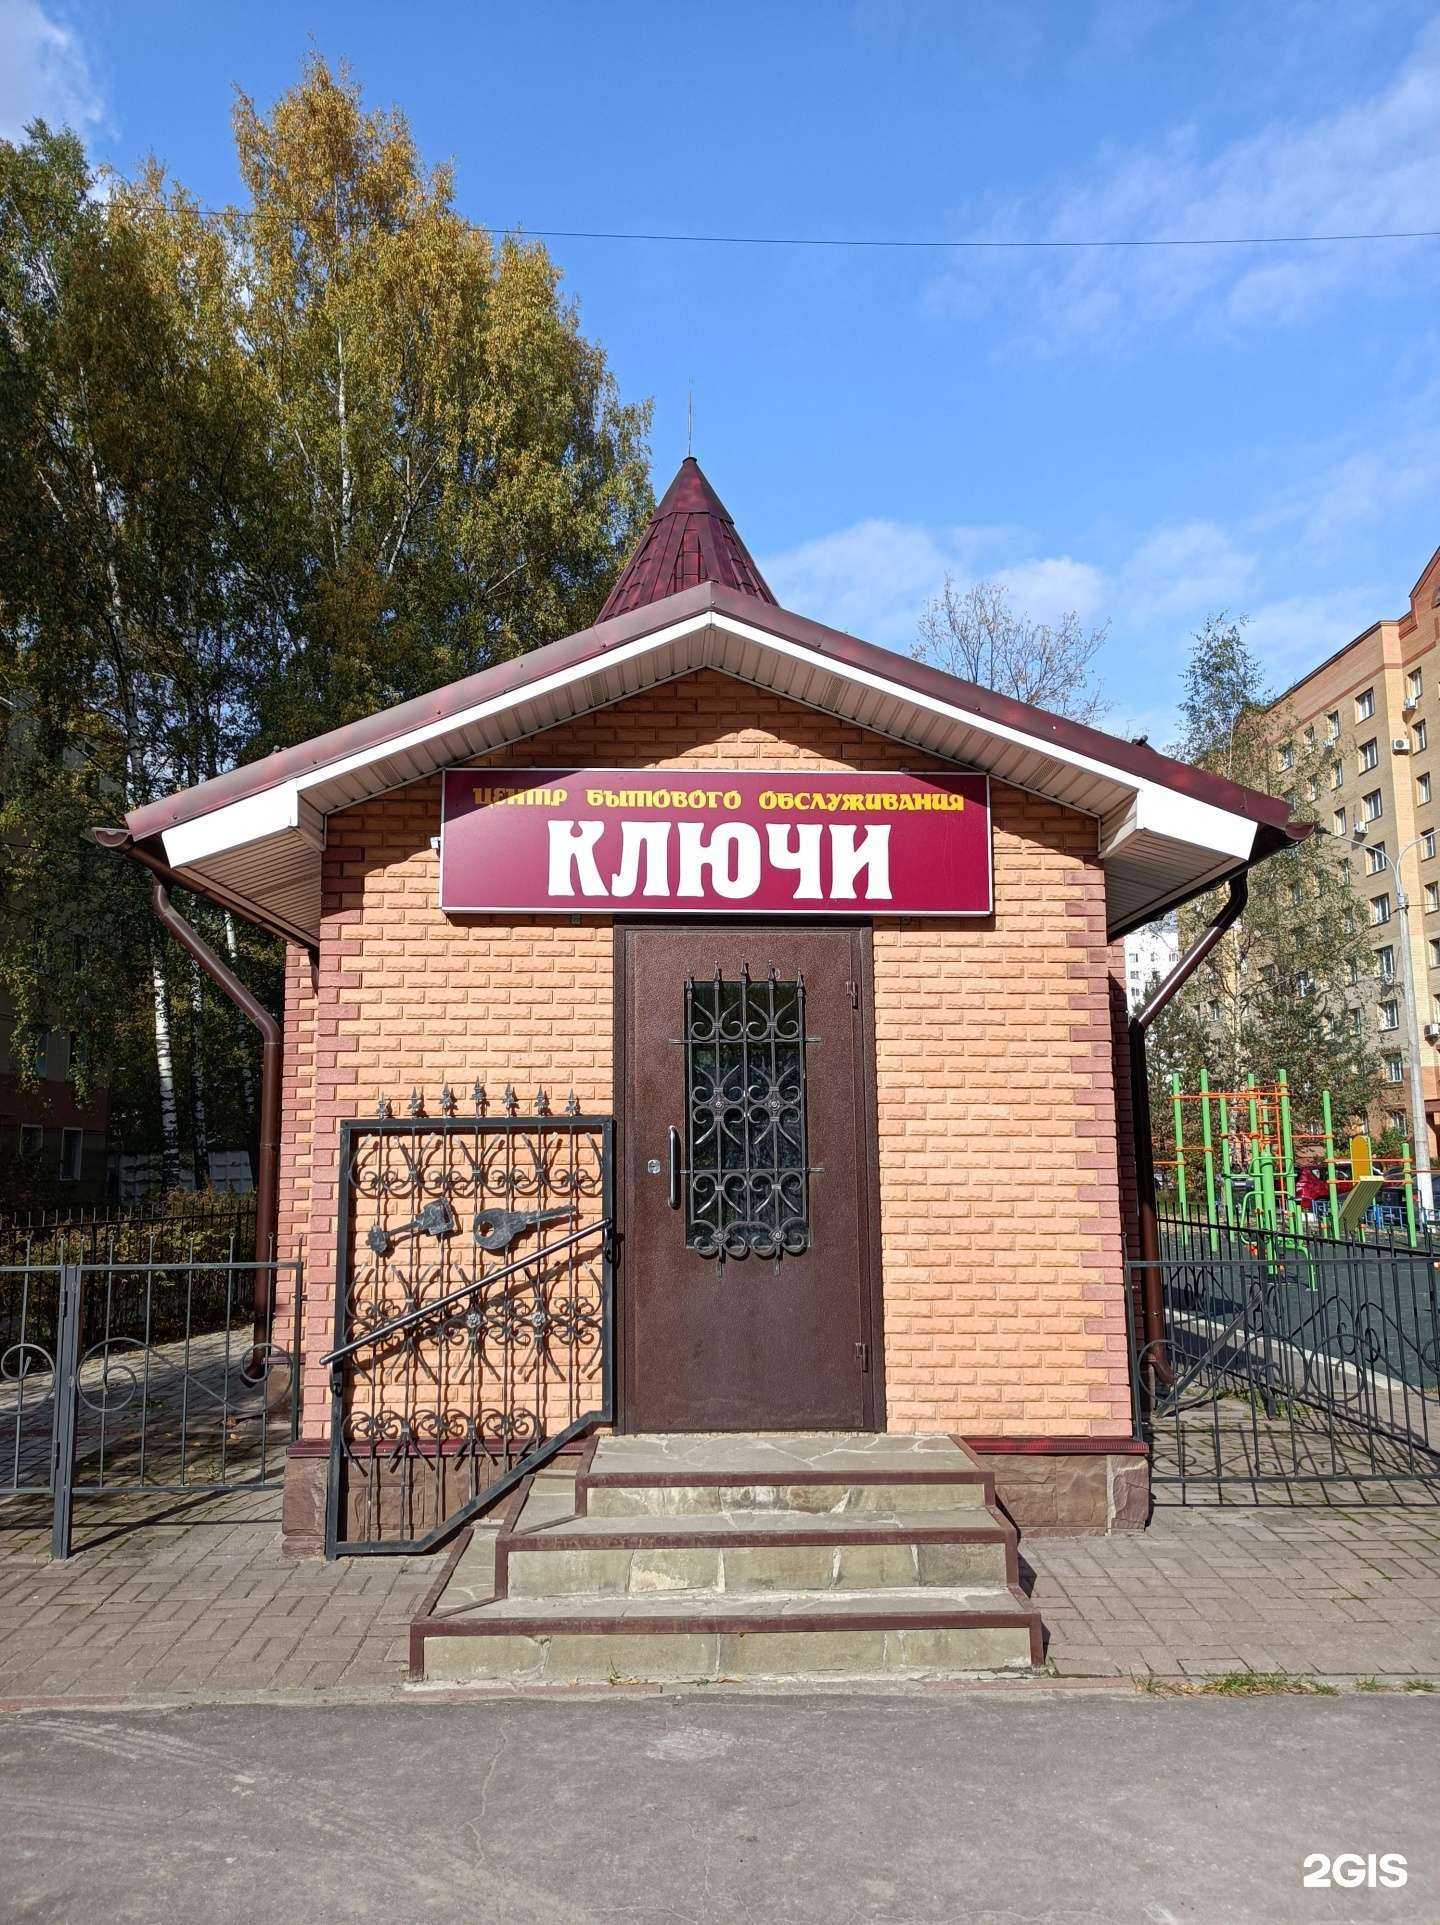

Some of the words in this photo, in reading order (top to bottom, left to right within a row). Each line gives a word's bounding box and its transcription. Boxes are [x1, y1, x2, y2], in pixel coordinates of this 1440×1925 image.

[473, 787, 567, 807] ЦЕНТР
[585, 789, 742, 810] БЫТОВОГО
[759, 791, 964, 811] ОБСЛУЖИВАНИЯ
[547, 820, 892, 899] КЛЮЧИ
